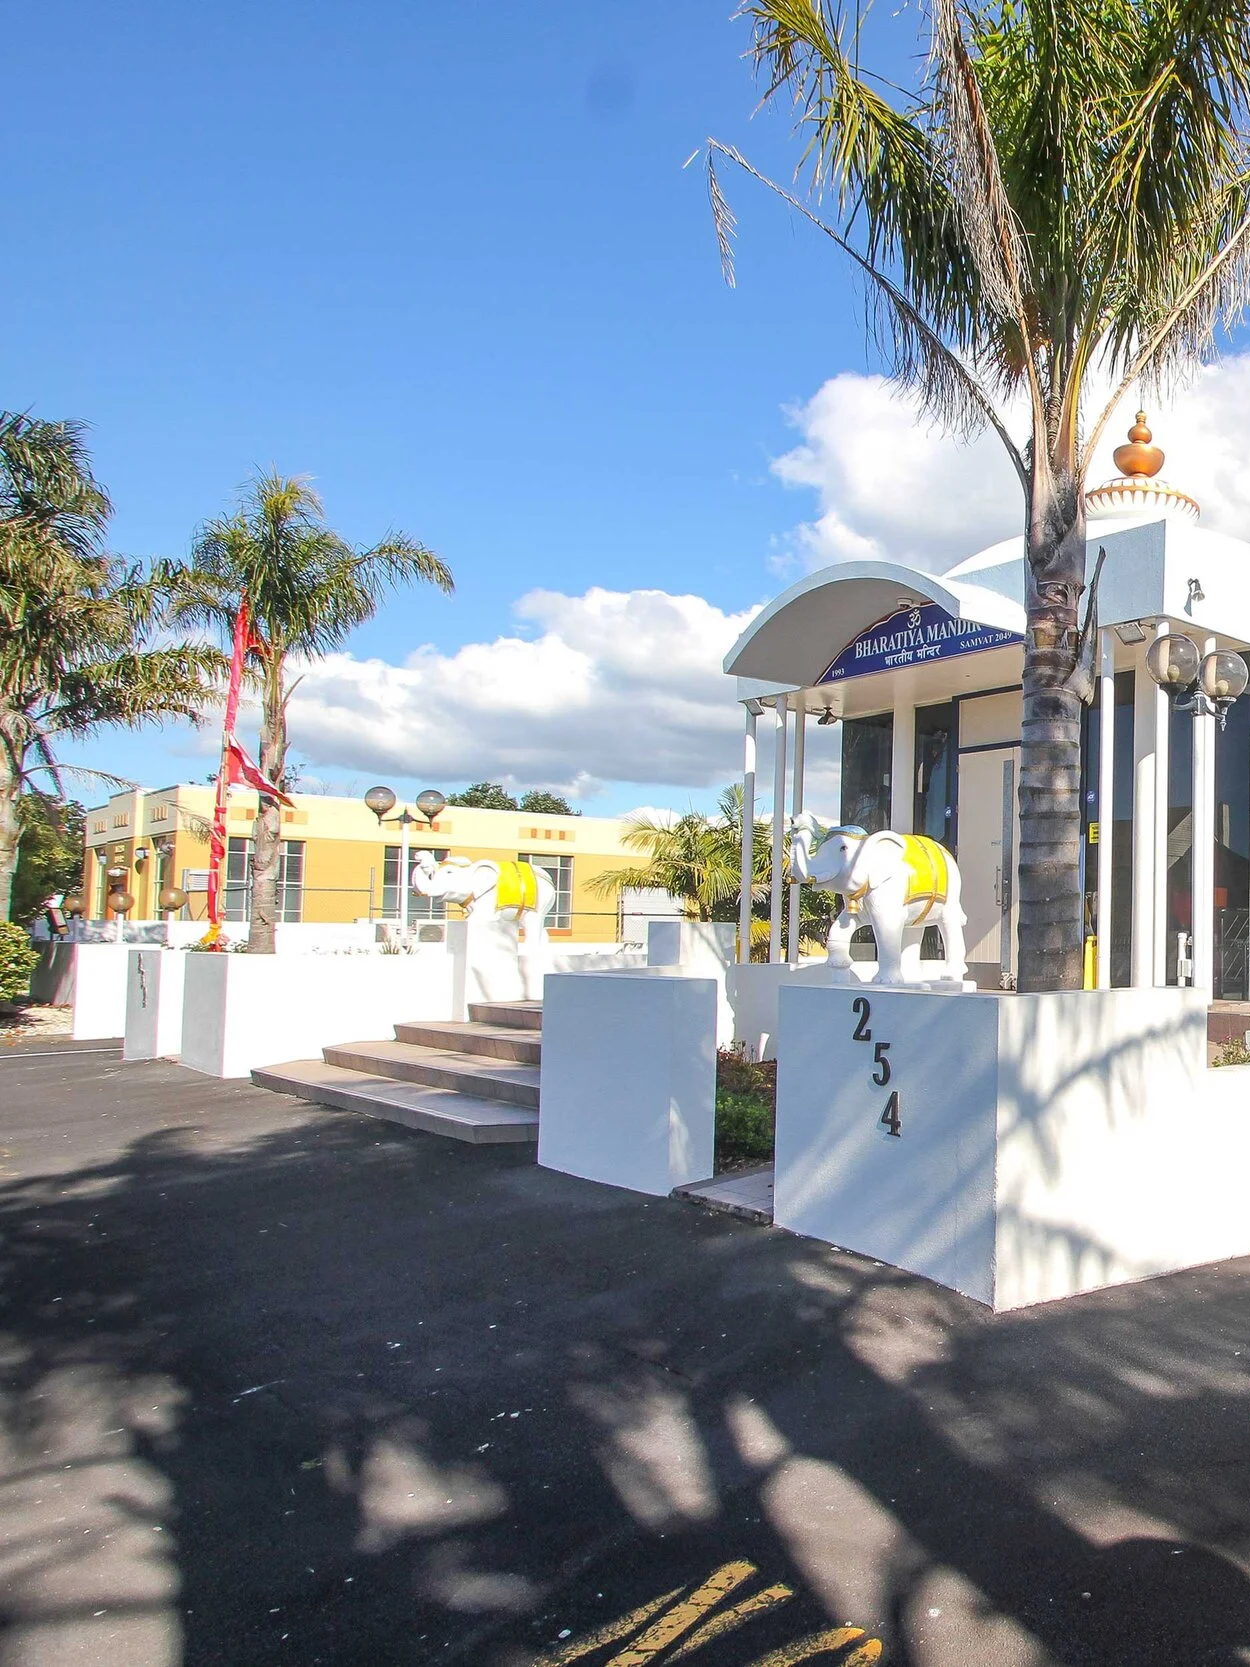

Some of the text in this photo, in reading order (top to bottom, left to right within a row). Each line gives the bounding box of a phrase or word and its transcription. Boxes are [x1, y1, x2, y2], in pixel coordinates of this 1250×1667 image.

[855, 628, 924, 659] BHARATIYA
[960, 632, 1012, 649] SAMVAT 2049
[884, 649, 913, 666] भारतीय
[831, 668, 845, 677] 1993
